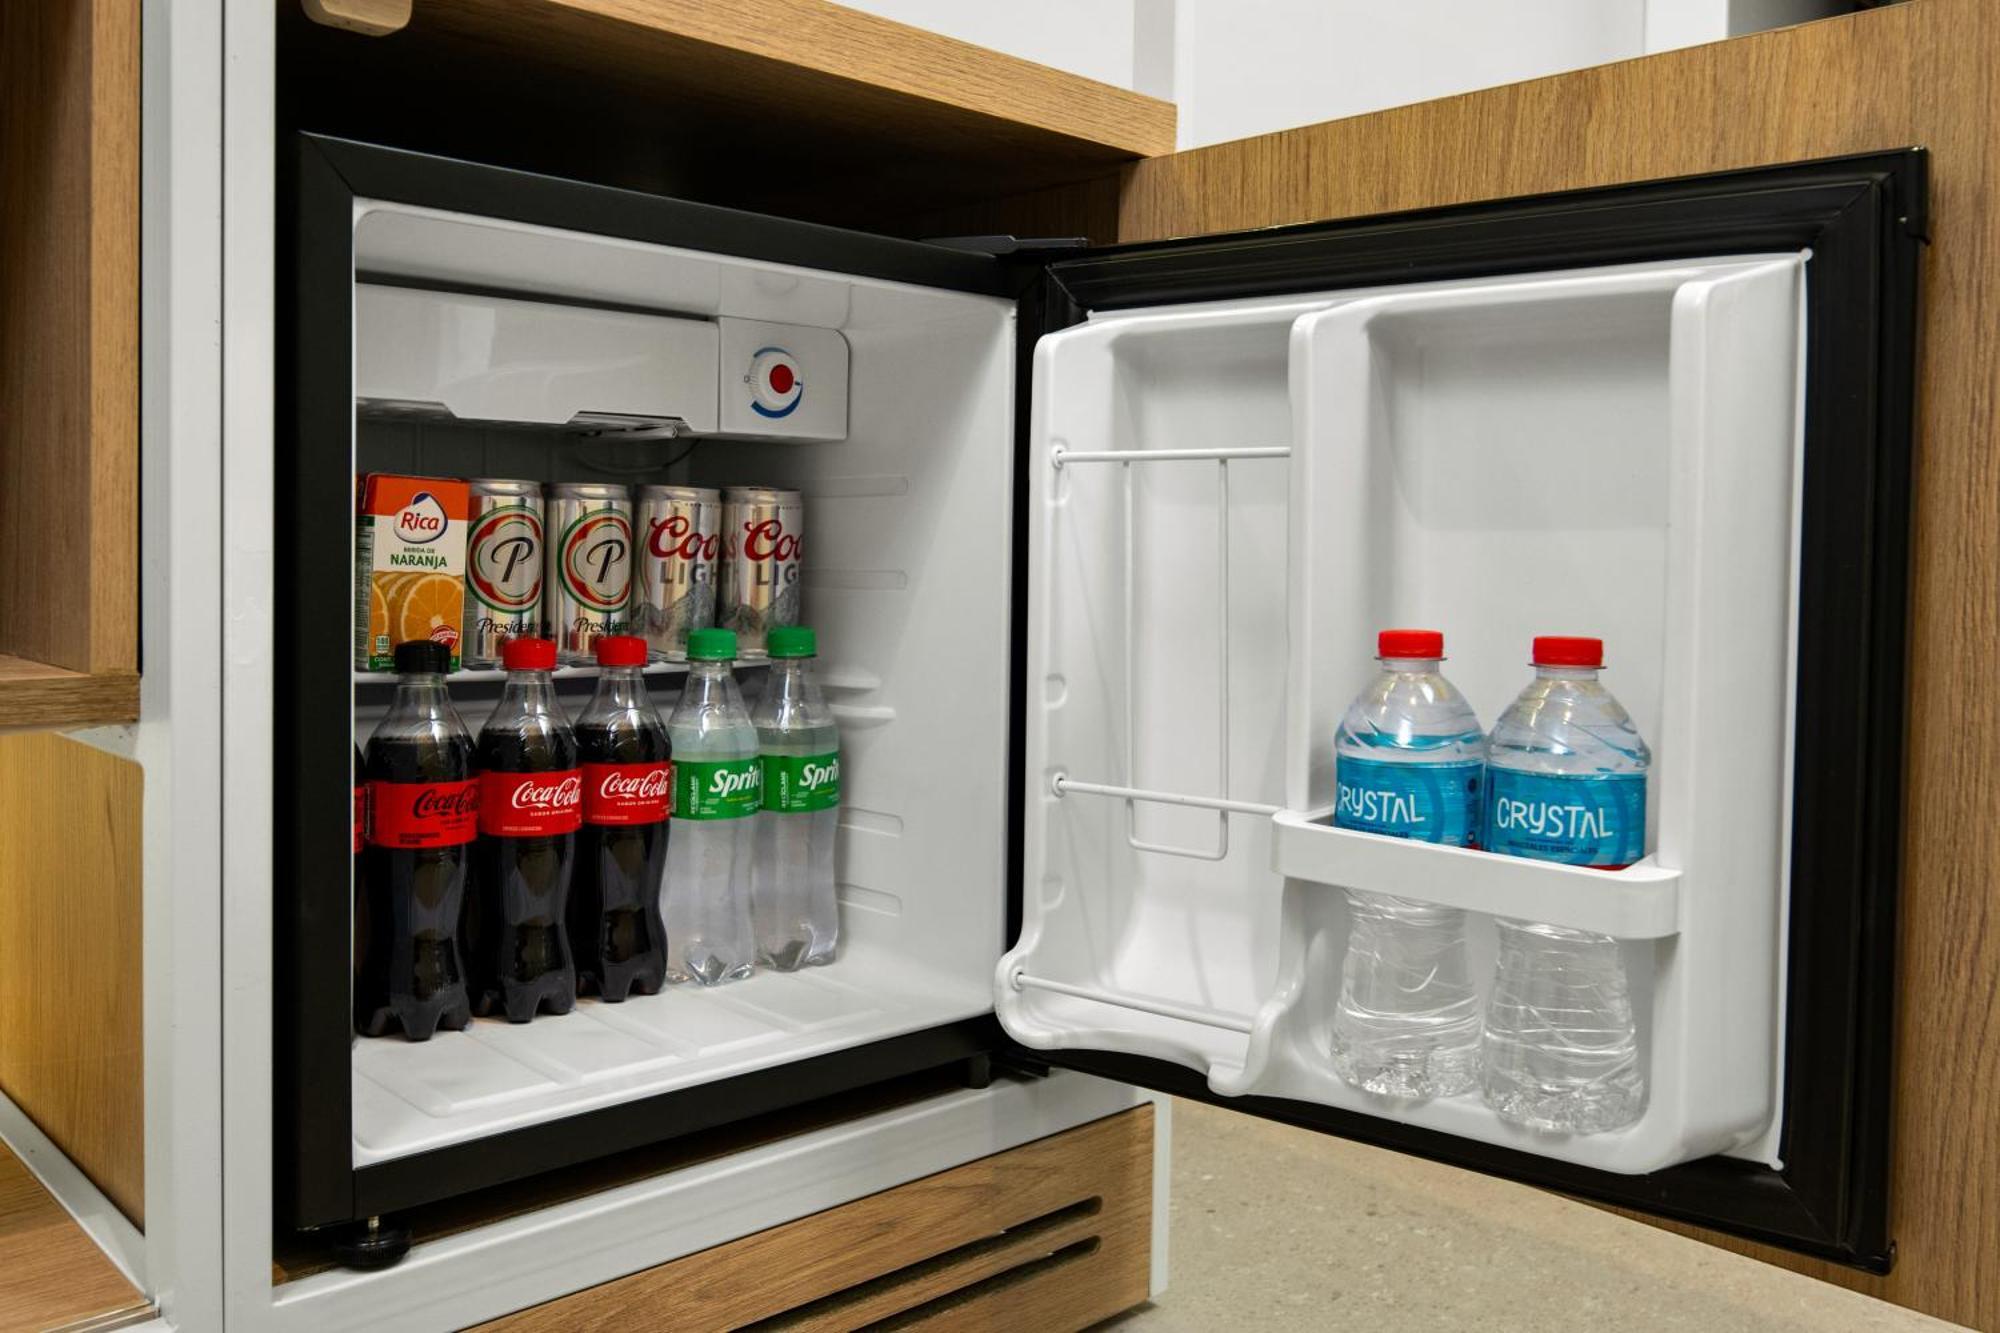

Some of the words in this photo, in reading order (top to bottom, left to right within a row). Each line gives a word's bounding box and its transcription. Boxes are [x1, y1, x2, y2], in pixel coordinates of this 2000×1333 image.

[400, 511, 440, 531] Rica
[390, 554, 448, 569] NARANJA
[490, 536, 534, 583] P
[586, 539, 625, 584] P
[660, 561, 718, 585] LIGH
[756, 563, 800, 587] LIG
[600, 769, 669, 799] Coca-Cola
[708, 765, 760, 797] Sprit
[1497, 797, 1613, 839] CRYSTAL
